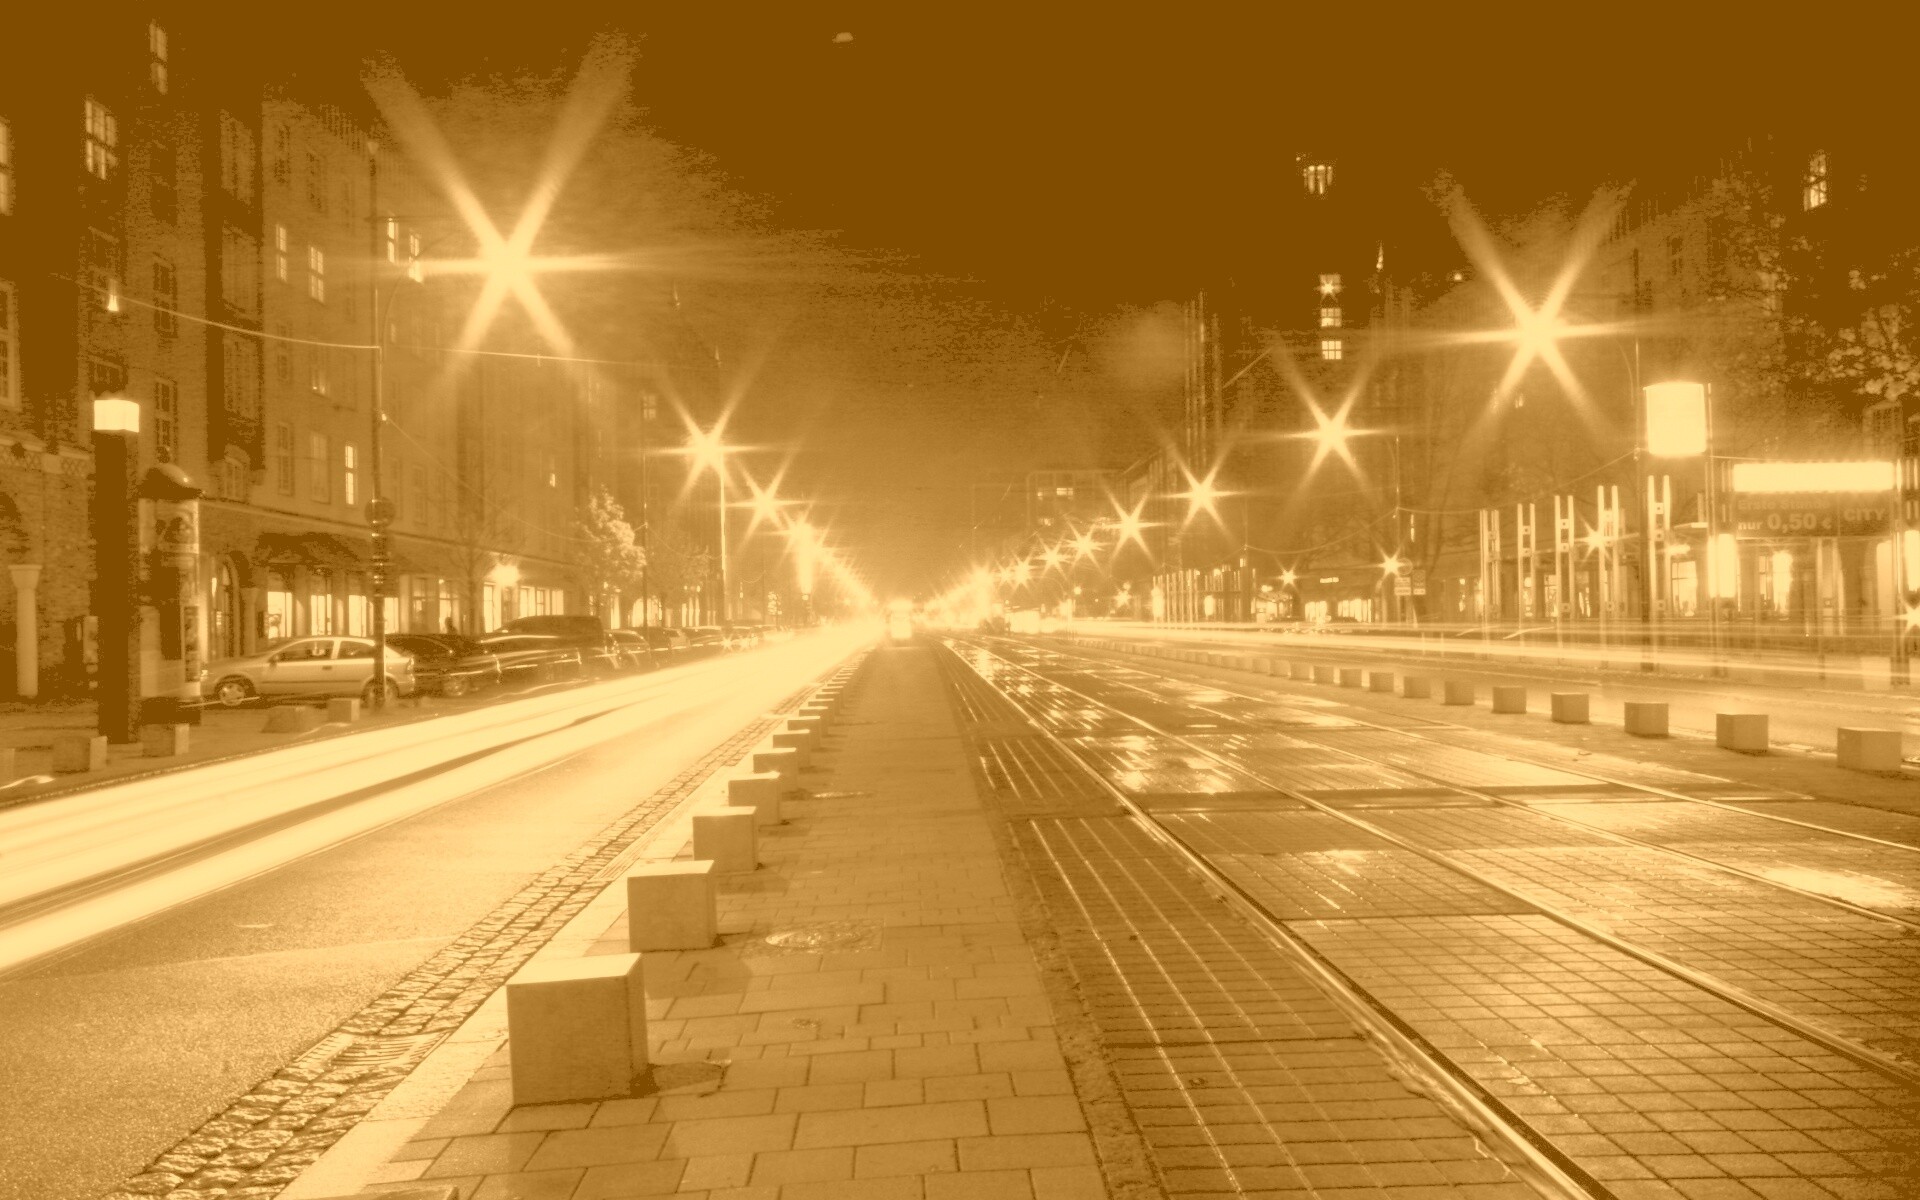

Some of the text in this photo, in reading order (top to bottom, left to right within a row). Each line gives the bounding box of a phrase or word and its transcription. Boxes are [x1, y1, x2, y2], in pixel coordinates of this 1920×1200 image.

[1843, 508, 1885, 521] CITY
[1738, 522, 1763, 531] nur
[1767, 513, 1817, 533] 0,50
